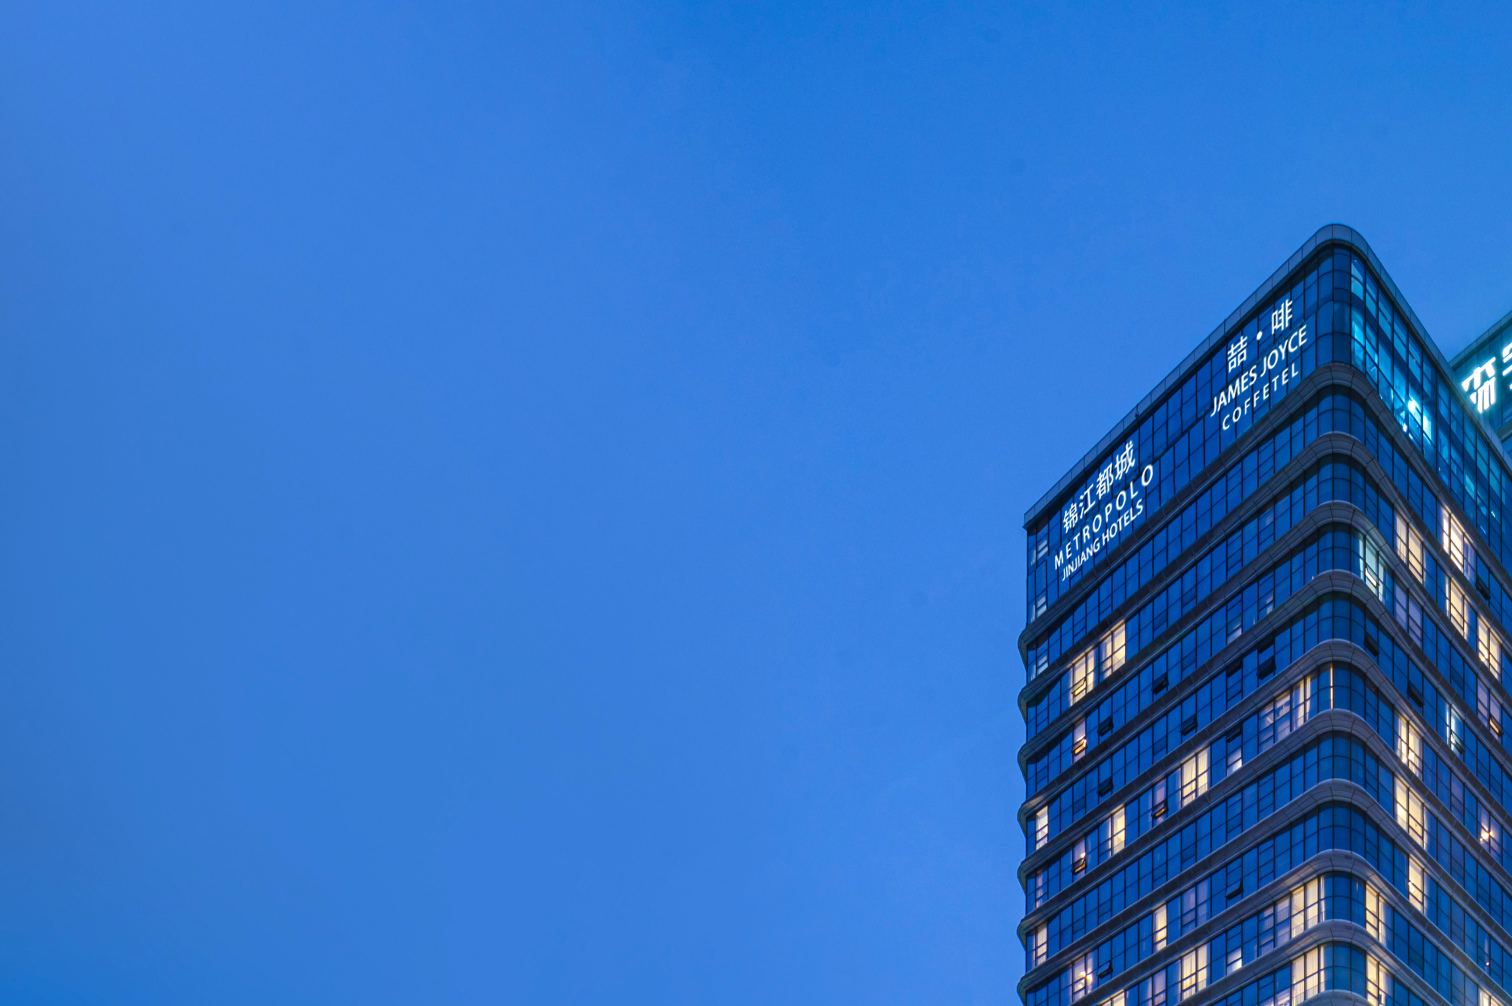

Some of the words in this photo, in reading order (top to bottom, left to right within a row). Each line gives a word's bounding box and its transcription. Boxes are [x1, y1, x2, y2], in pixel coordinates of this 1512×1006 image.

[1210, 364, 1258, 417] JAMES
[1260, 324, 1307, 377] JOYCE
[1222, 362, 1299, 430] COFFETEL
[1054, 464, 1153, 570] METROPOLO
[1062, 440, 1136, 534] 锦江都城
[1062, 537, 1101, 582] JINJIANG
[1101, 498, 1144, 547] HOTELS
